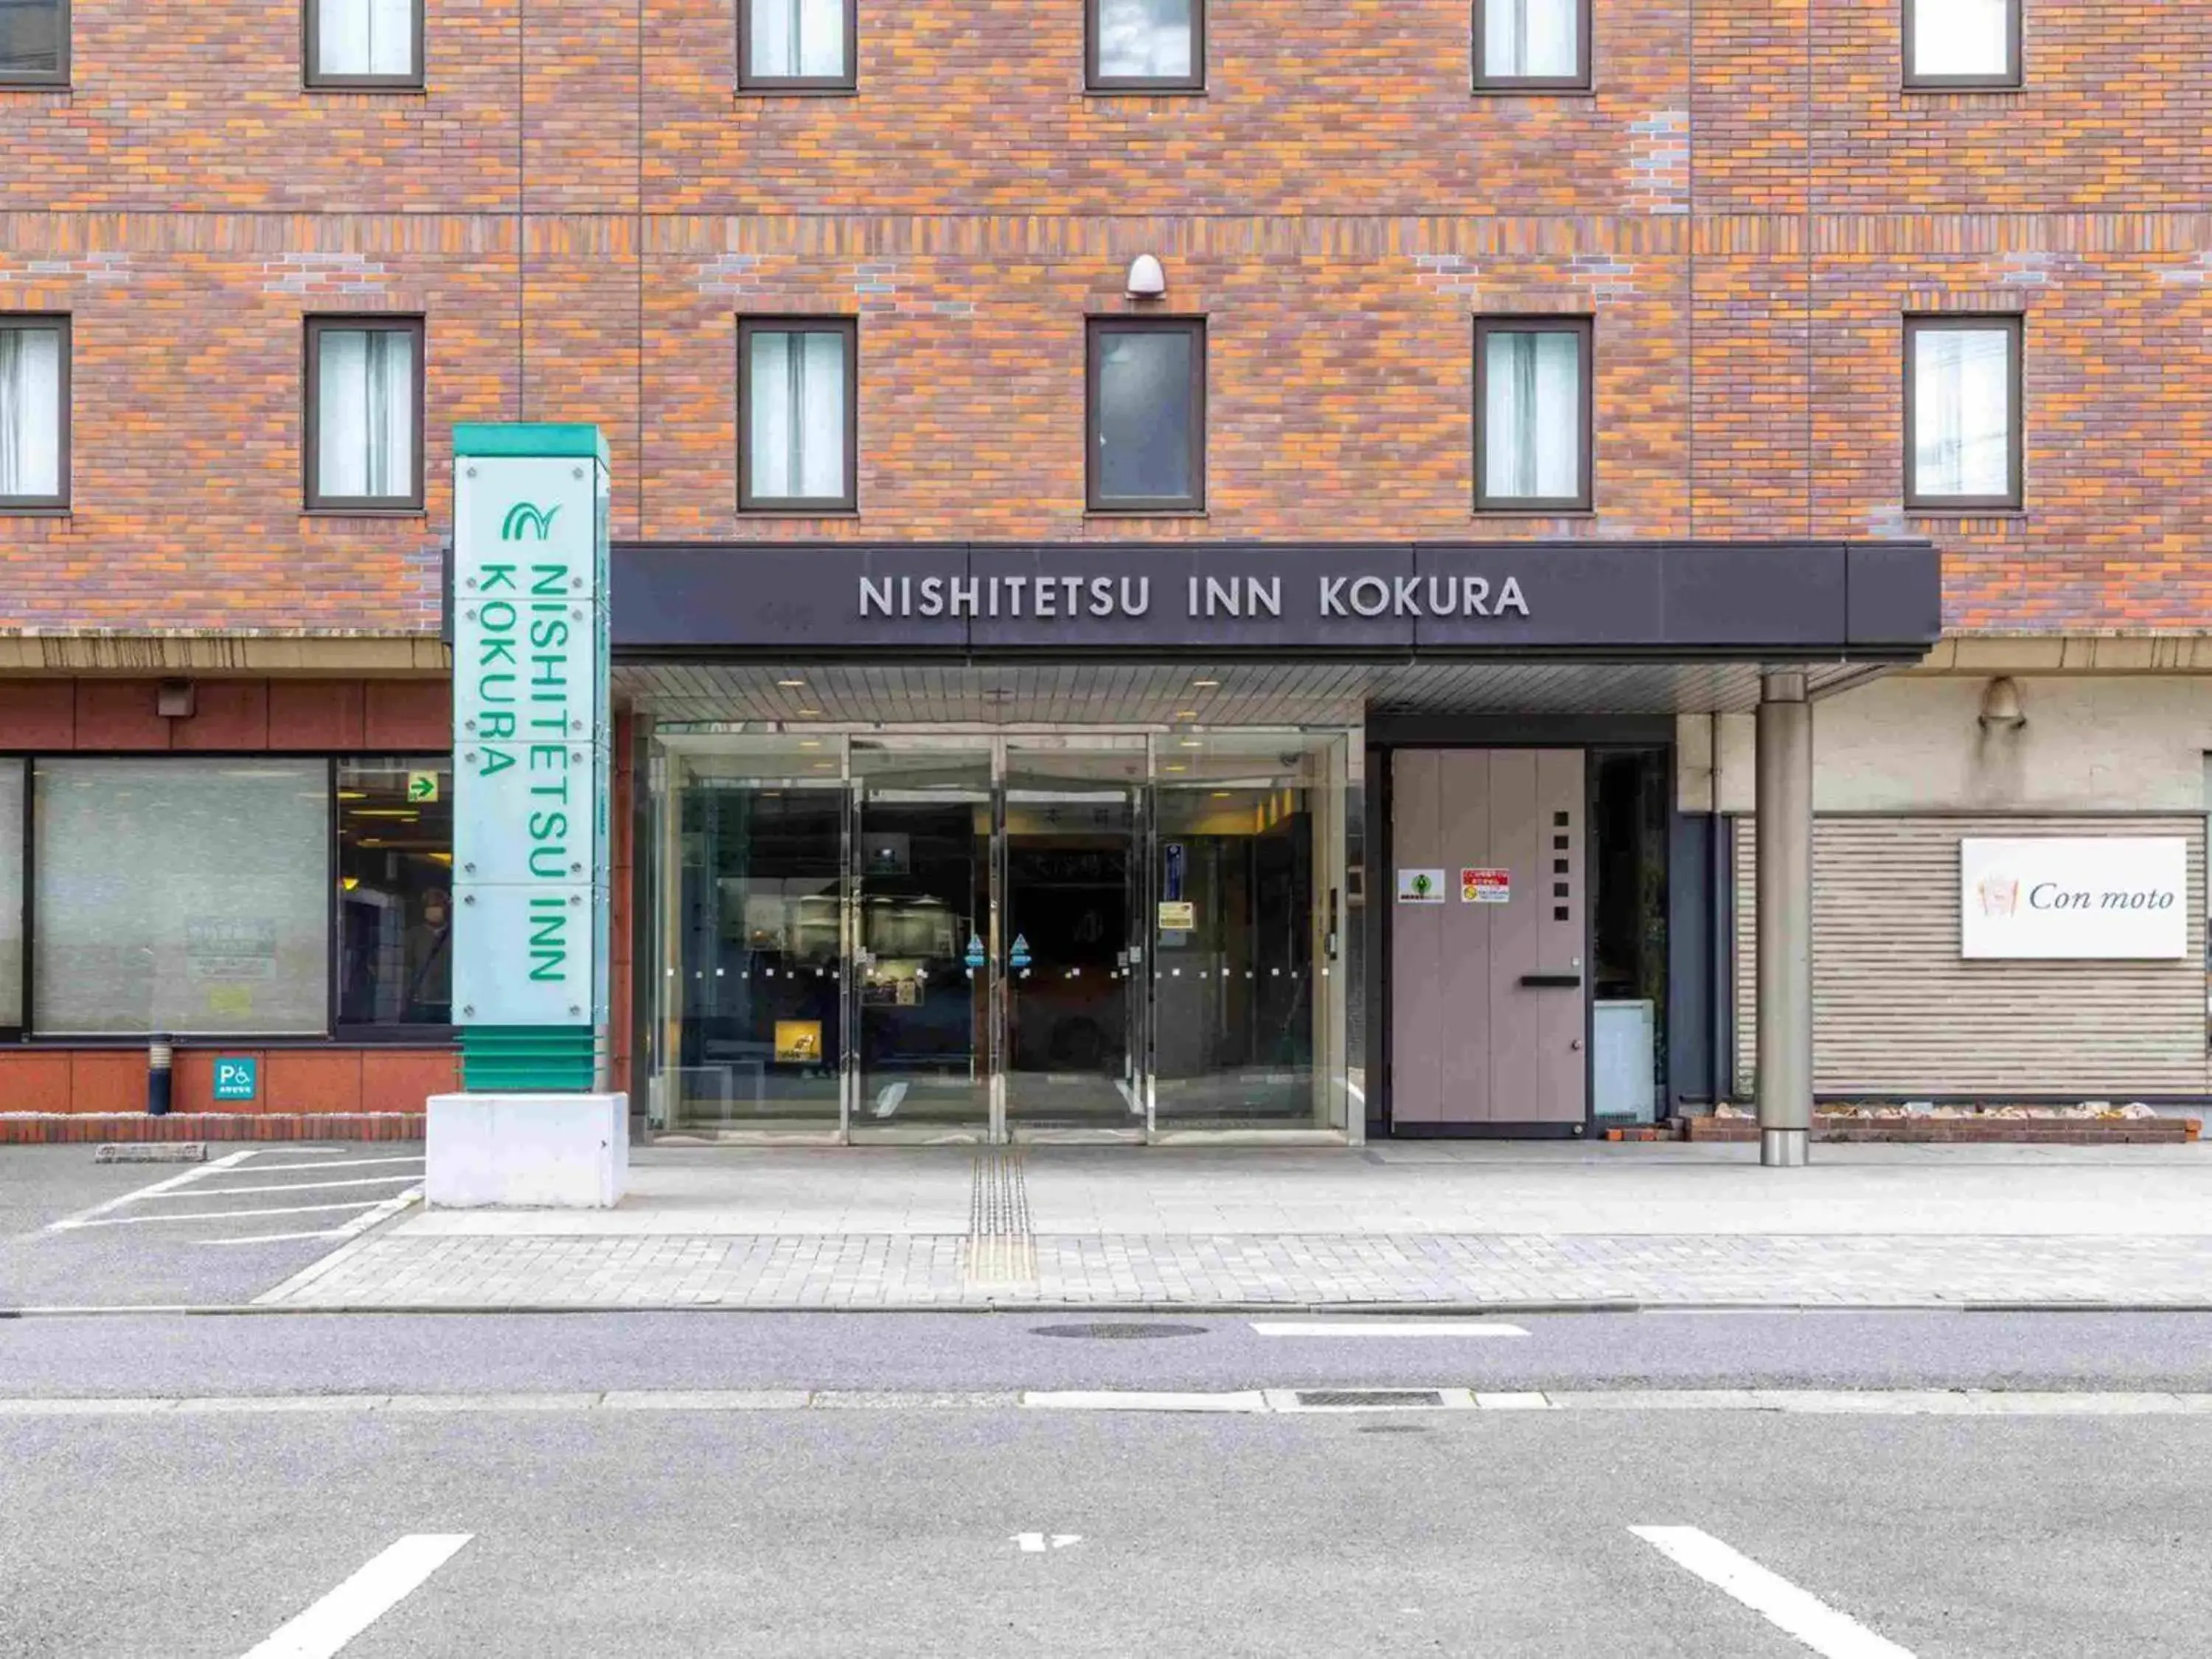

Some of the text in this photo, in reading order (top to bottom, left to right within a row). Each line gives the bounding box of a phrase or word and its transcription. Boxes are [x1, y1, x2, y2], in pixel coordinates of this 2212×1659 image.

[858, 576, 1531, 616] NISHITETSU INN KOKURA
[479, 565, 517, 776] KOKURA
[529, 565, 568, 982] NISHITETSU INN
[2029, 882, 2175, 910] Con moto
[220, 1065, 235, 1084] P
